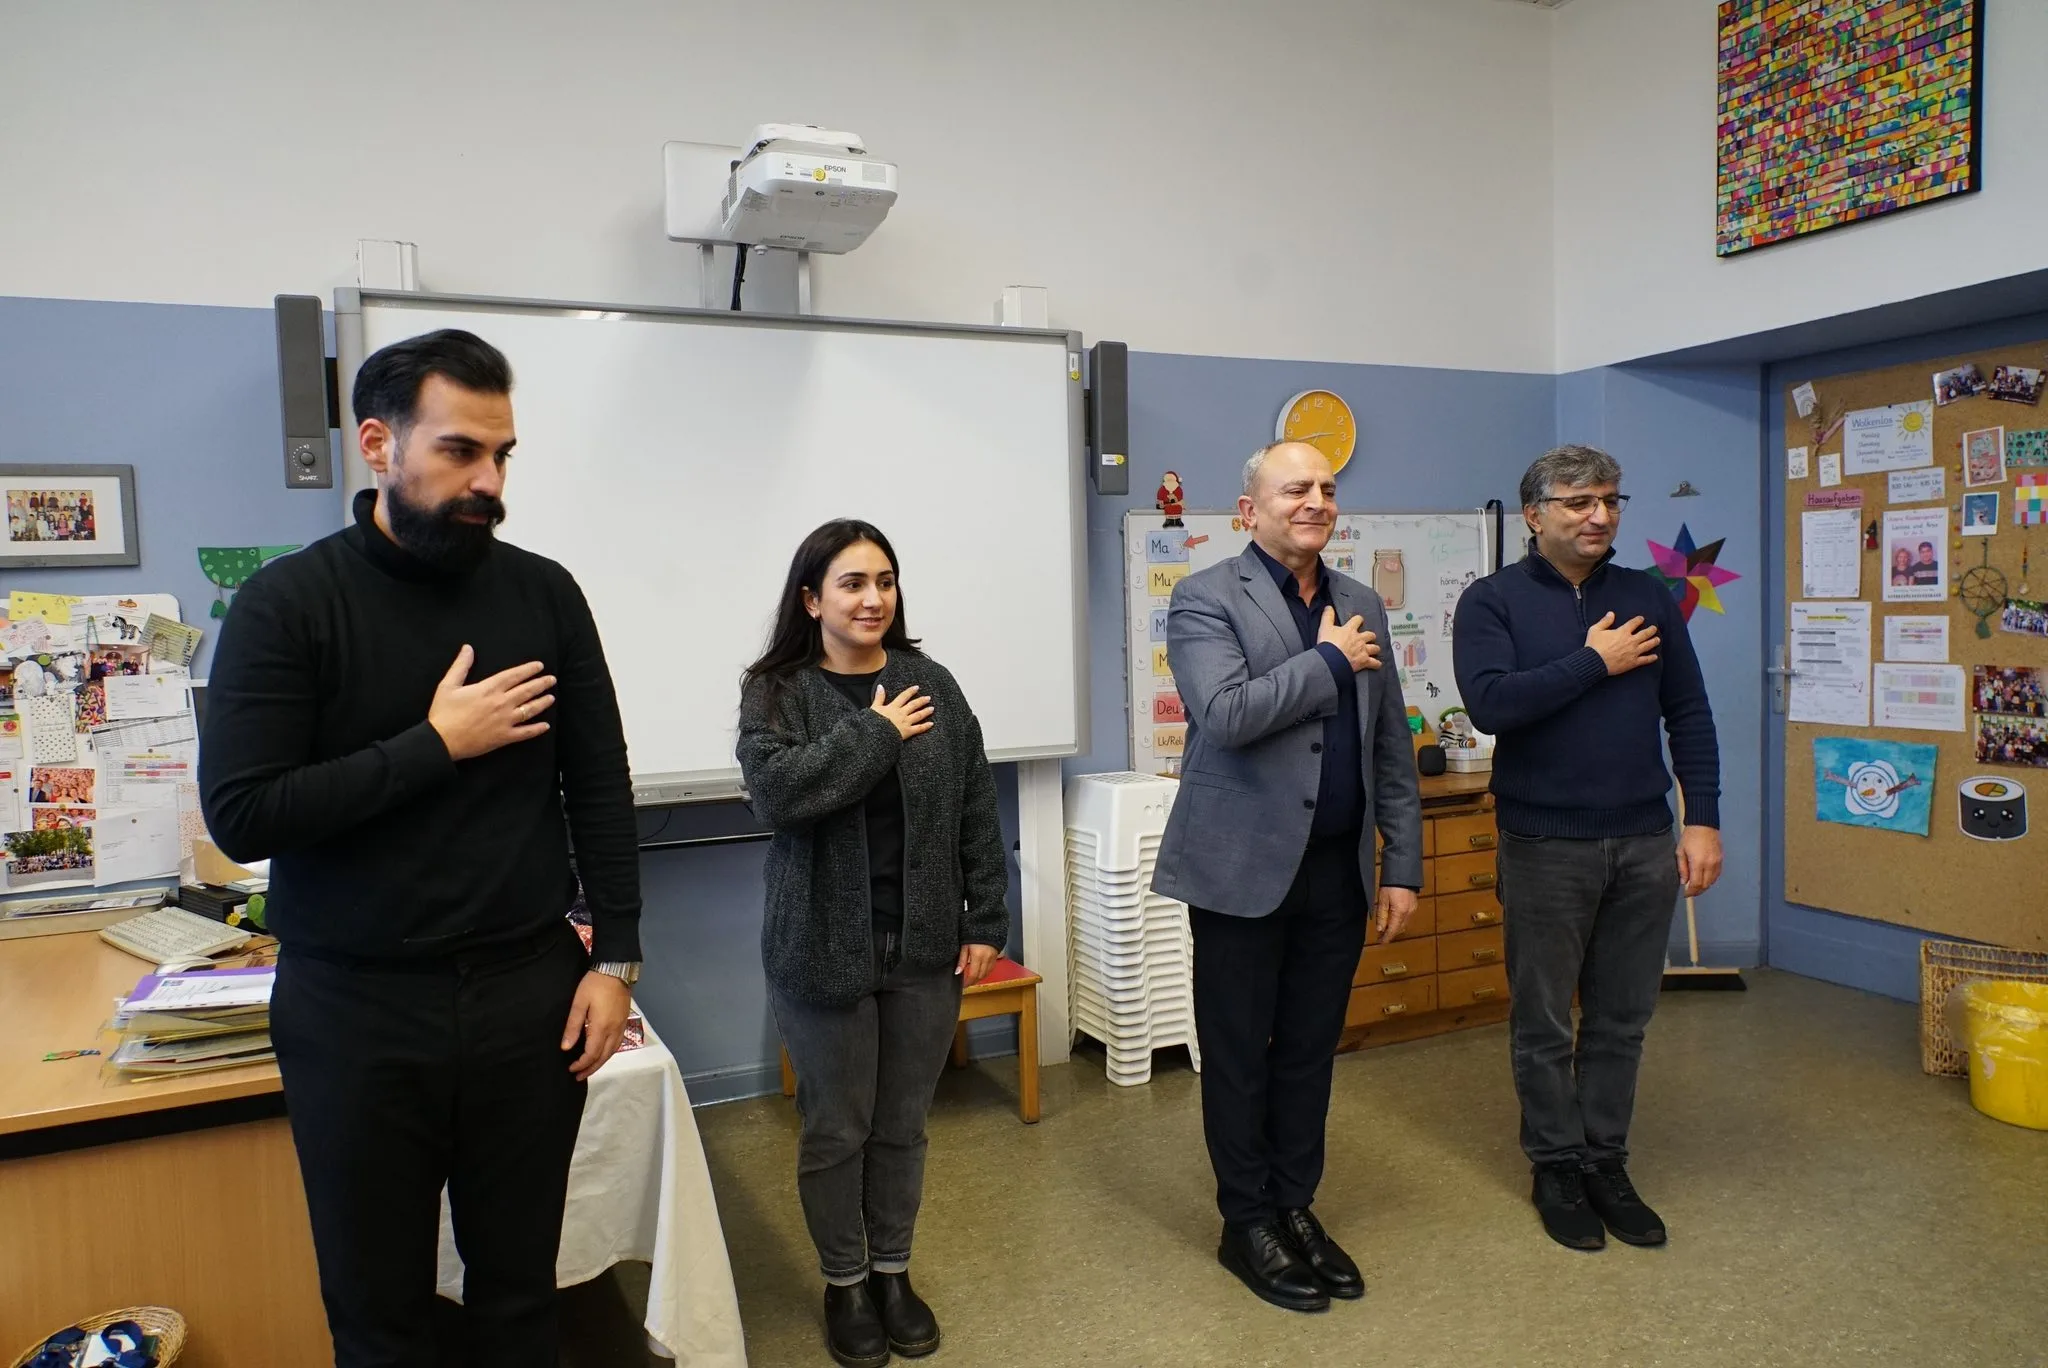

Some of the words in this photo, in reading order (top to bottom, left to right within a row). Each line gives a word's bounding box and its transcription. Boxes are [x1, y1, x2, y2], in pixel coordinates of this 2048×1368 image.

[824, 164, 847, 173] EPSON
[1851, 415, 1893, 428] Wolkenlos
[1807, 492, 1860, 507] Hausaufgaben
[1151, 539, 1169, 554] Ma
[1154, 572, 1172, 587] Mu
[1155, 618, 1167, 632] M
[1157, 700, 1180, 715] Deu
